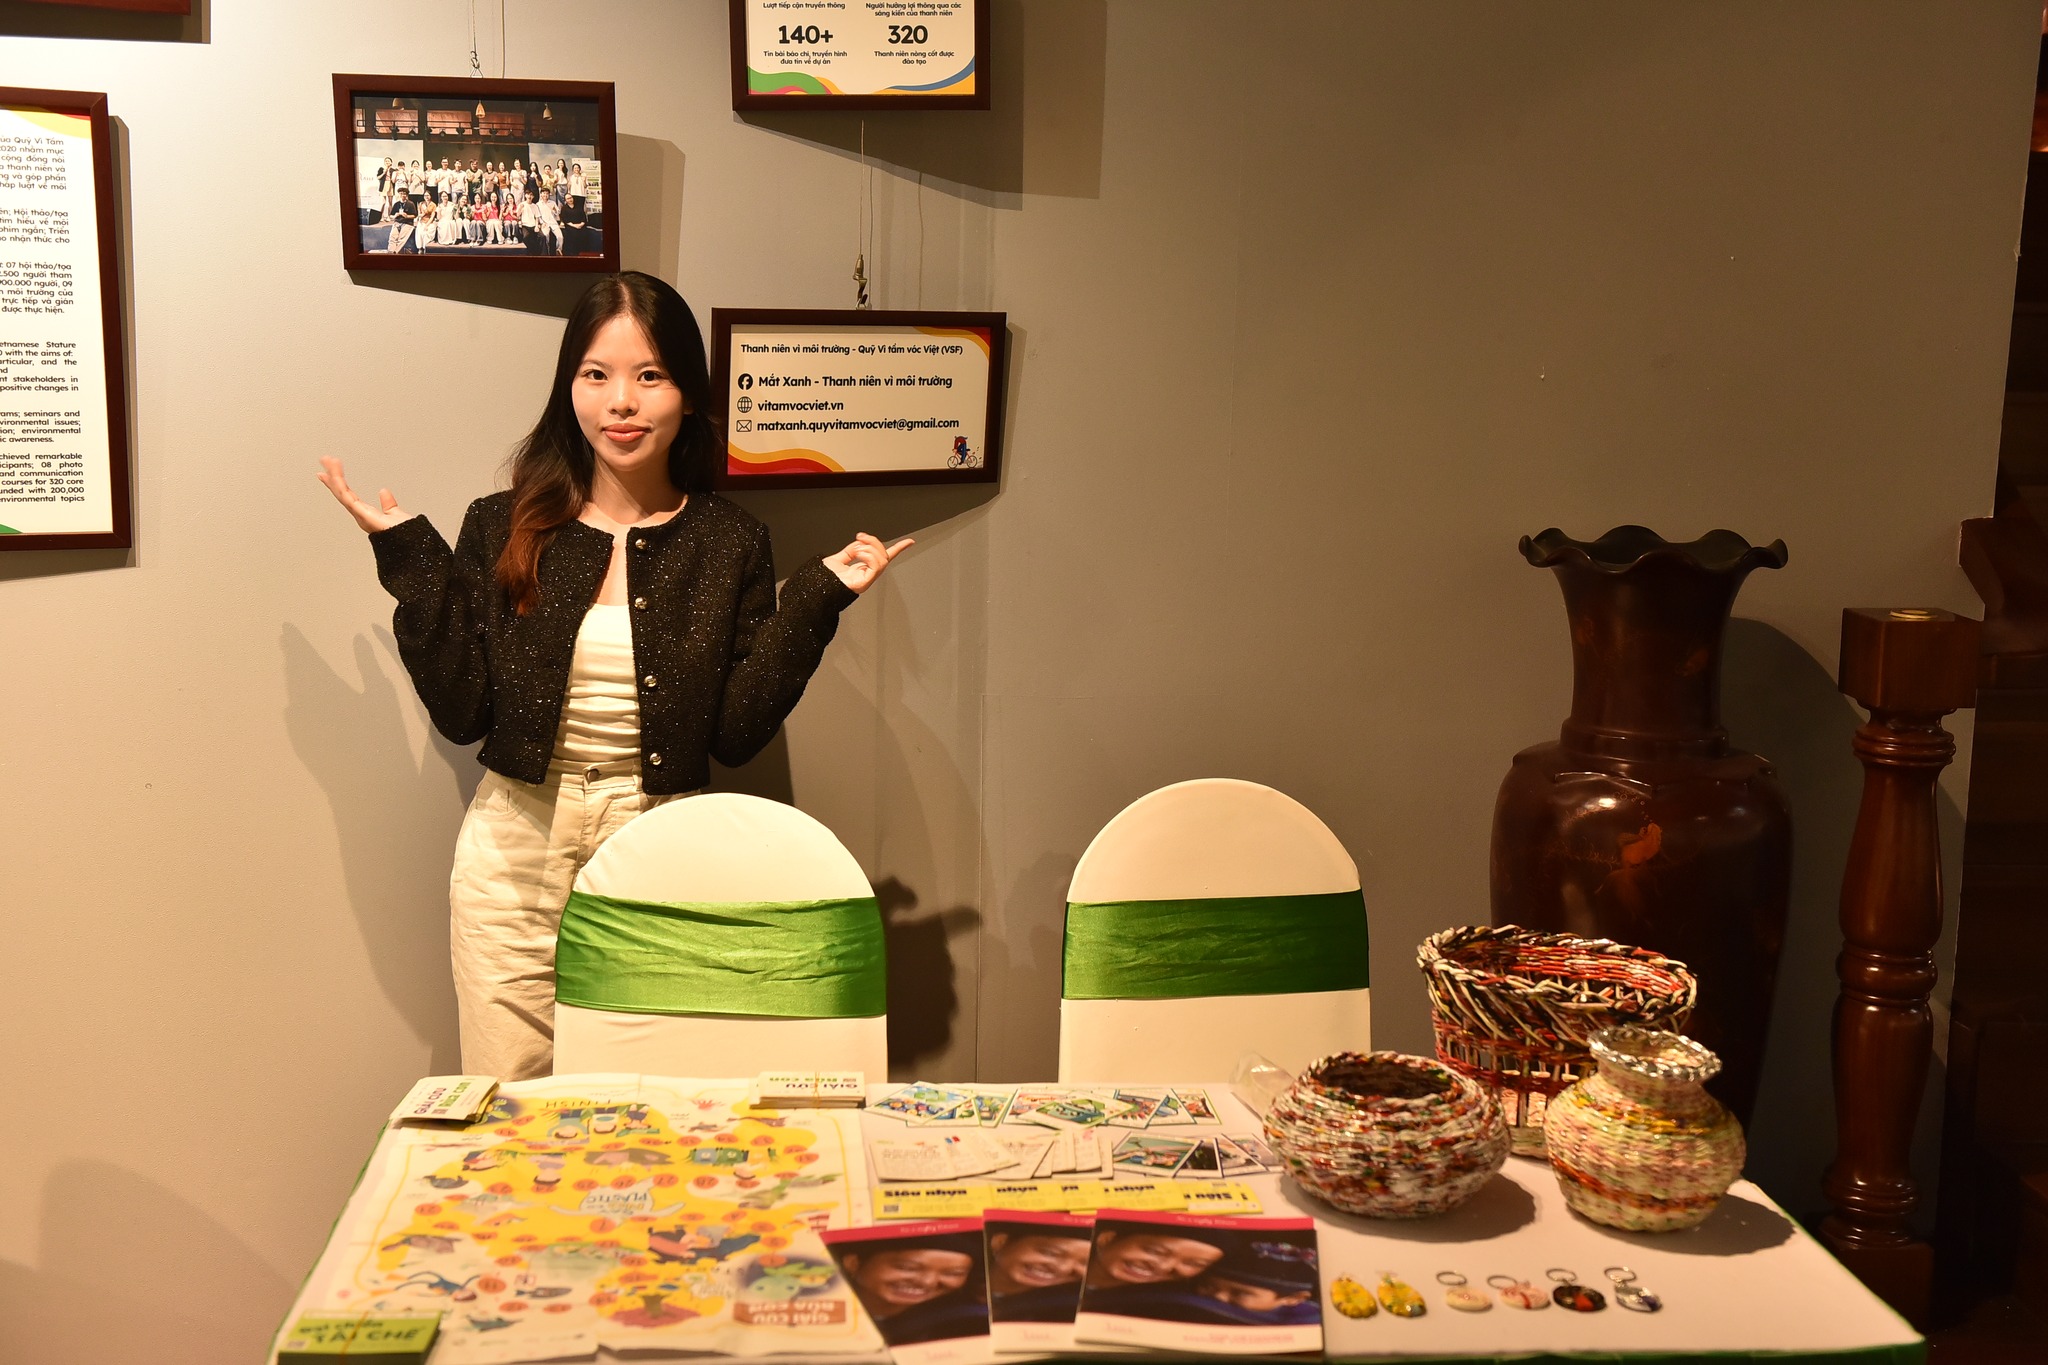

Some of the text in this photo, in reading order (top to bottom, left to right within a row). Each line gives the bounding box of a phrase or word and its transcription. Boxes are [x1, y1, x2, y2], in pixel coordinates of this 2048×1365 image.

[779, 1, 790, 9] tiếp
[803, 1, 825, 9] truyền
[866, 2, 884, 10] Người
[886, 2, 906, 10] hưởng
[917, 2, 935, 10] thông
[892, 8, 905, 16] kiến
[779, 25, 833, 44] 140+
[888, 25, 928, 44] 320
[812, 50, 832, 59] truyền
[804, 55, 811, 64] về
[741, 344, 769, 353] Thanh
[772, 344, 790, 353] niên
[793, 344, 800, 353] vì
[803, 344, 819, 353] môi
[821, 344, 850, 355] trường
[858, 345, 876, 355] Quỹ
[878, 345, 886, 353] Vì
[888, 343, 904, 353] tầm
[907, 345, 921, 353] vóc
[923, 345, 939, 355] Việt
[941, 346, 963, 355] (VSF)
[759, 373, 780, 386] Mắt
[783, 376, 811, 386] Xanh
[822, 376, 856, 386] Thanh
[859, 375, 881, 386] niên
[884, 376, 893, 386] vì
[896, 376, 915, 386] môi
[918, 376, 952, 388] trường
[34, 385, 69, 393] changes
[758, 400, 843, 411] vitamvocviet.vn
[757, 417, 959, 433] matxanh.quyvitamvocviet@gmail.com
[59, 461, 83, 470] photo
[61, 495, 85, 503] topics
